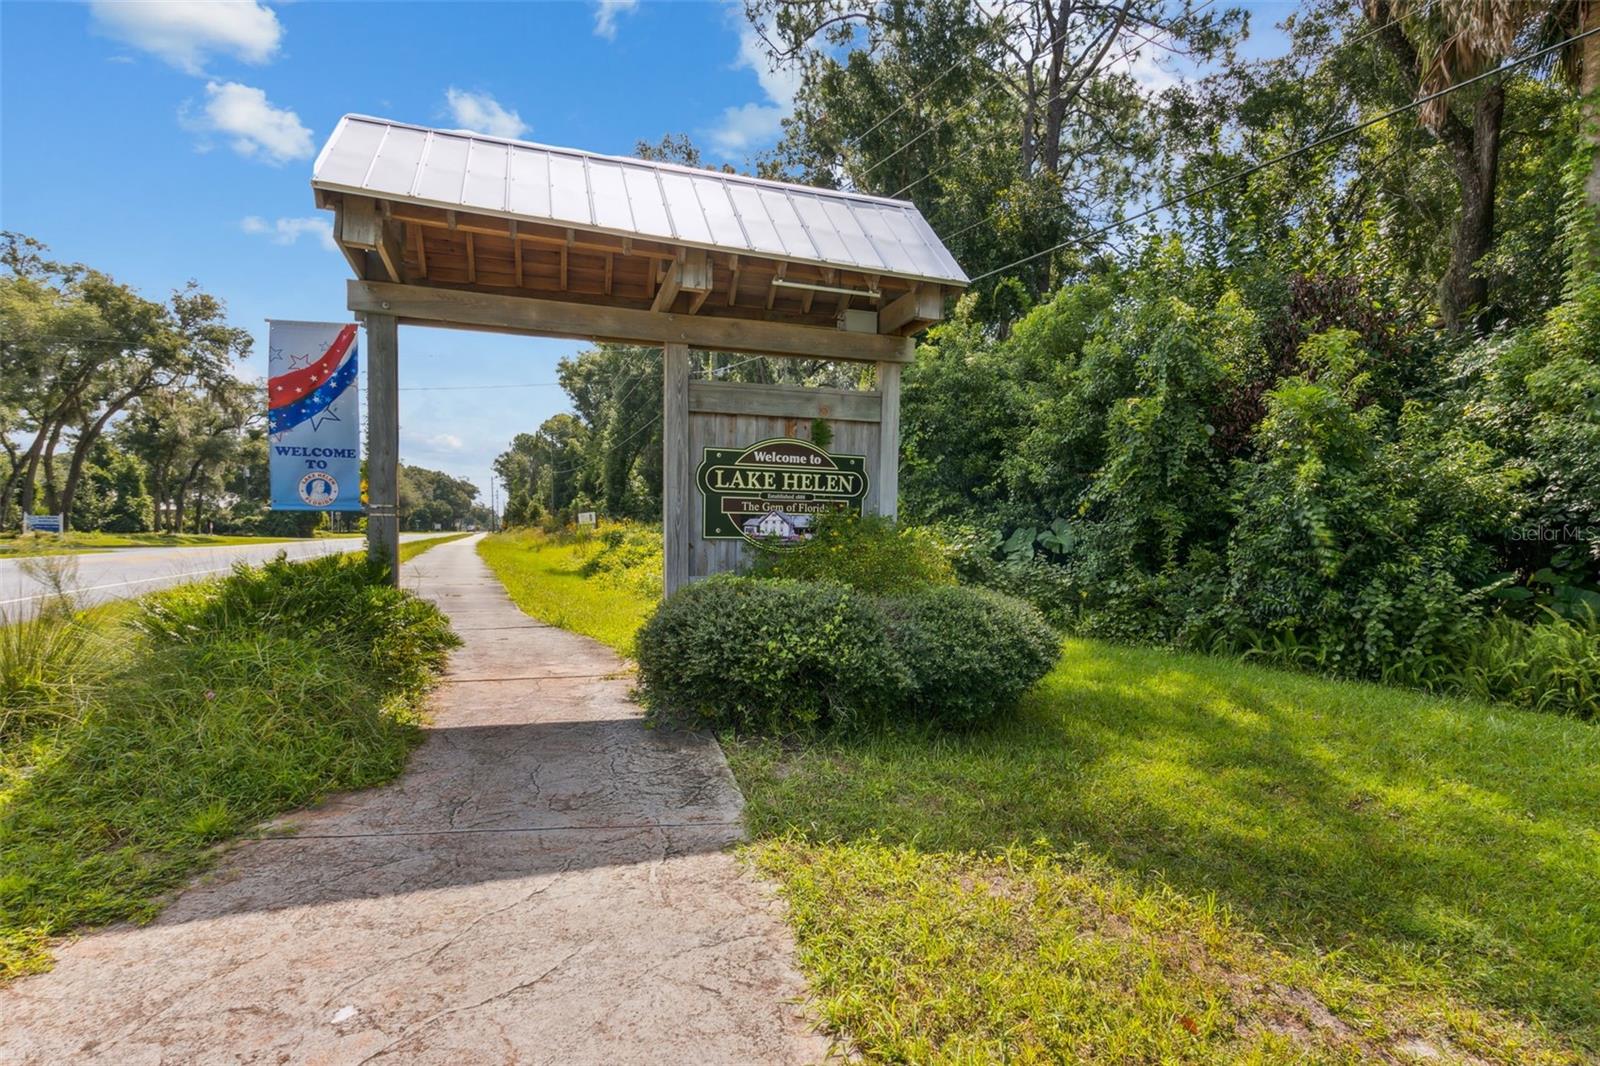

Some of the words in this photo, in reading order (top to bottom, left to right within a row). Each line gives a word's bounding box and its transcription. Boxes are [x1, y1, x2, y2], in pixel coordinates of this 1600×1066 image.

[275, 446, 356, 458] WELCOME
[754, 451, 807, 464] Welcome
[809, 454, 822, 465] to
[305, 459, 328, 469] TO
[714, 470, 777, 490] LAKE
[782, 472, 854, 493] HELEN
[741, 501, 760, 511] The
[762, 502, 784, 513] Gem
[786, 503, 798, 512] of
